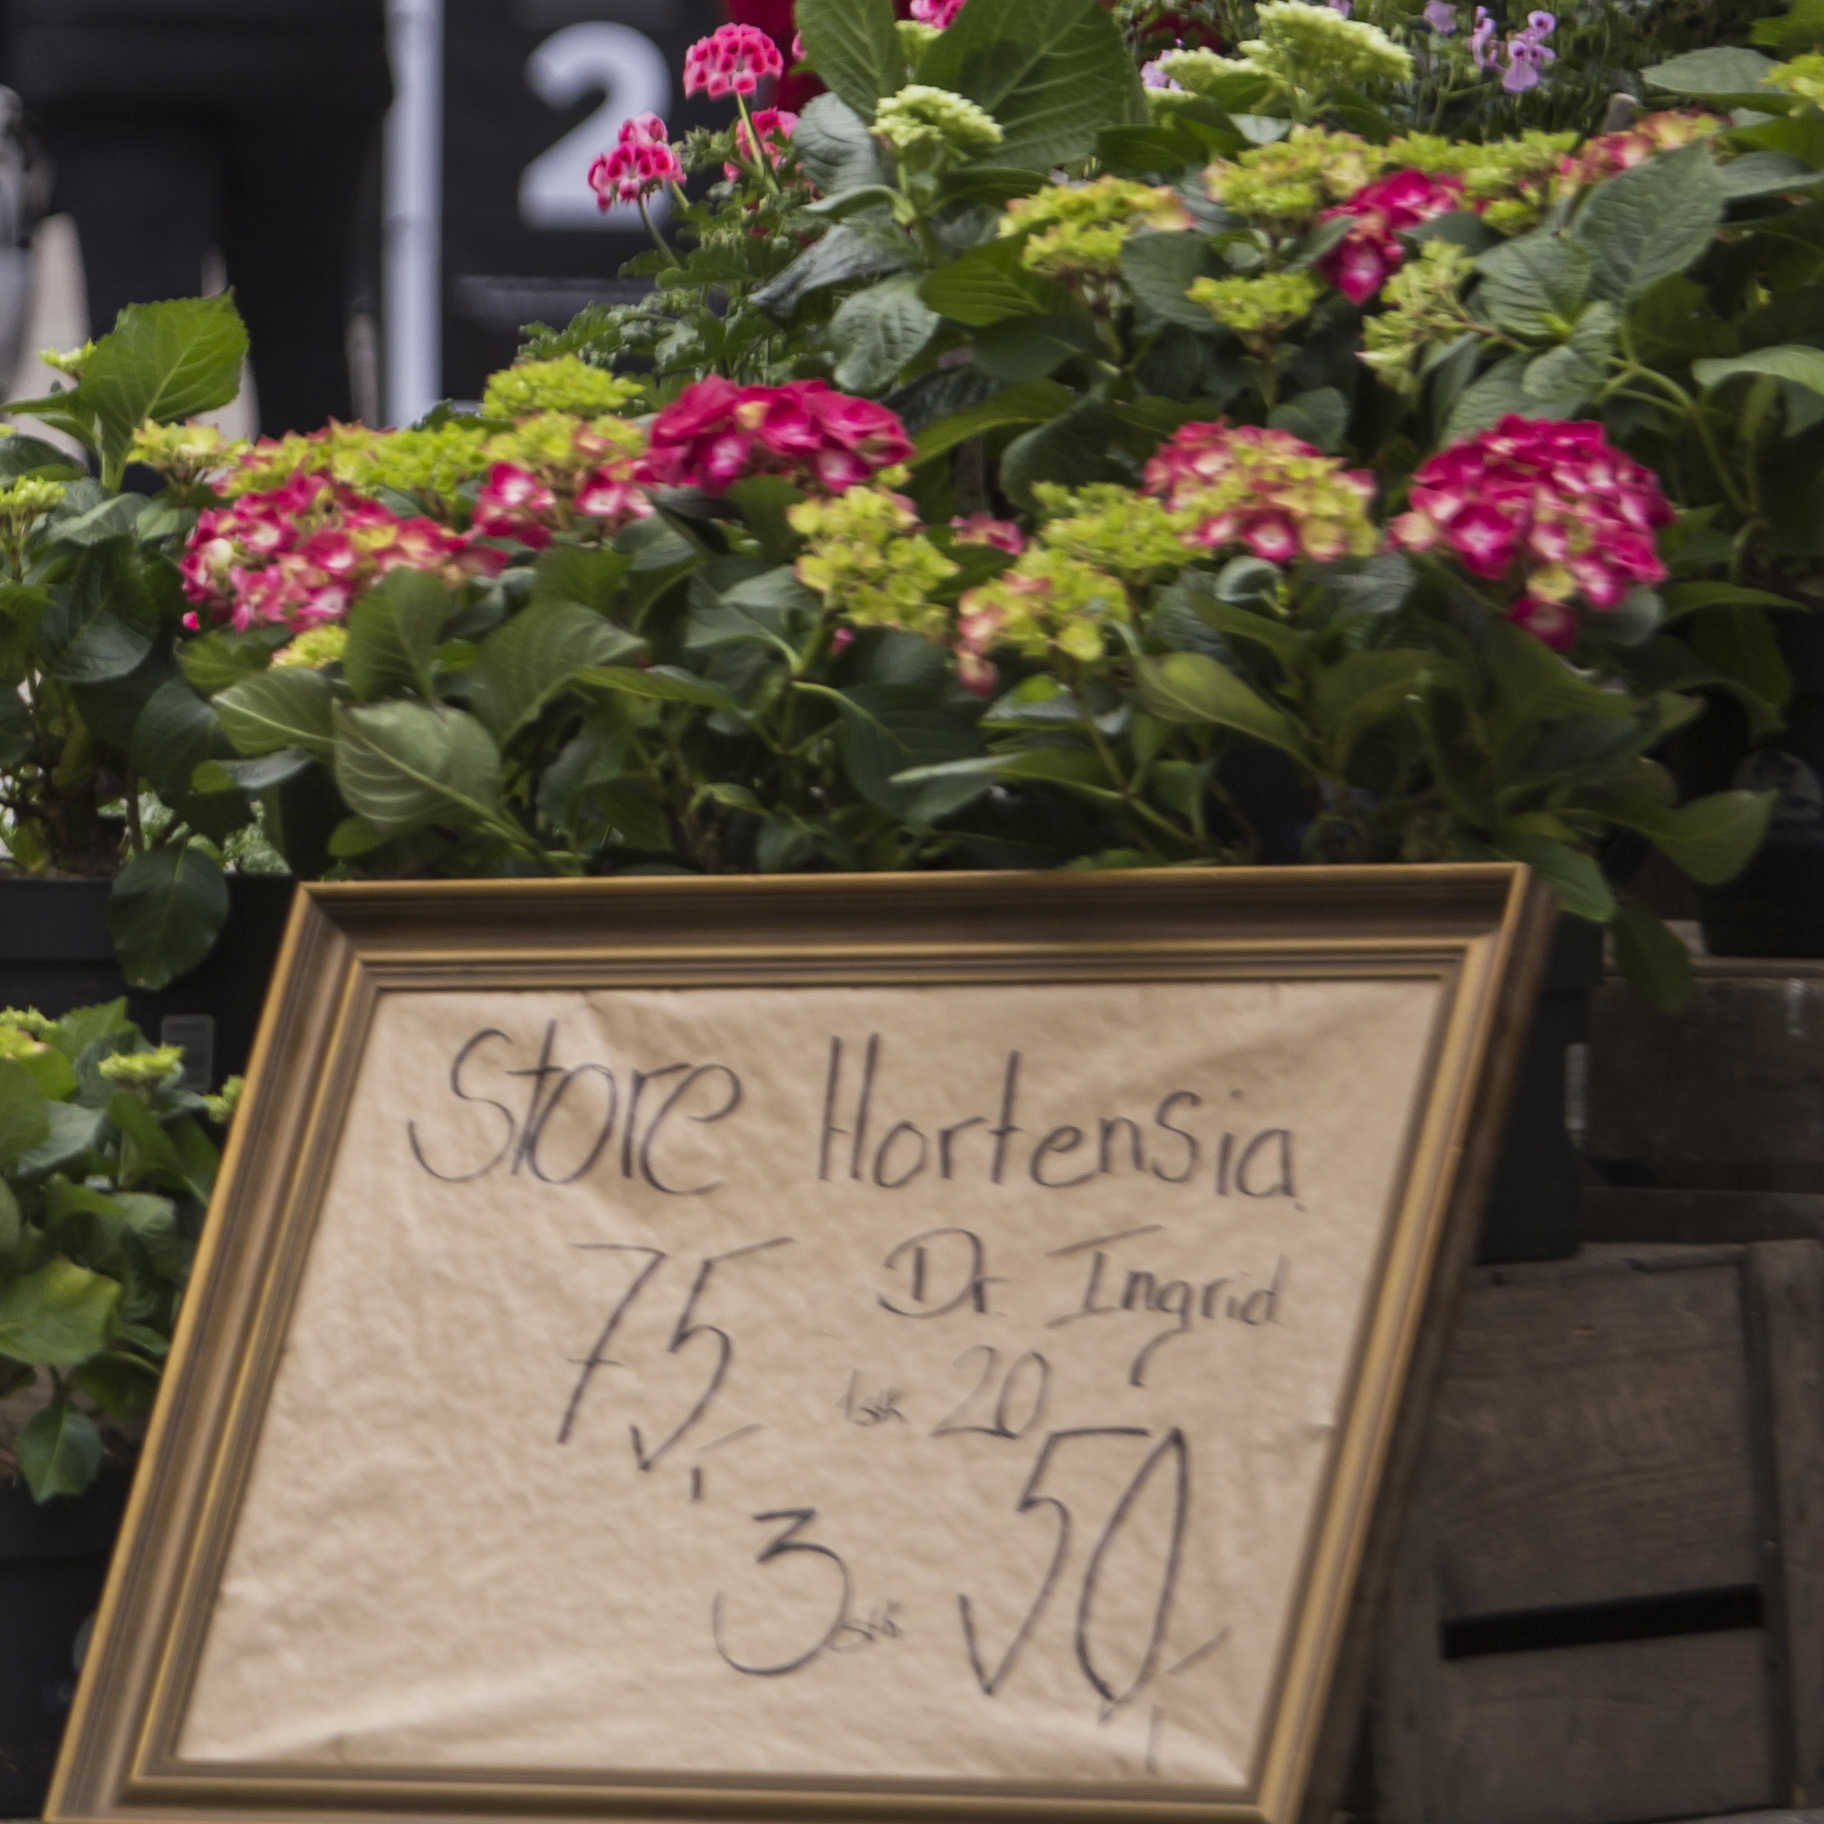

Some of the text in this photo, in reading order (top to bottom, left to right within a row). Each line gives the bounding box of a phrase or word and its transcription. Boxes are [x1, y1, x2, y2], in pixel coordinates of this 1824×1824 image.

[518, 20, 671, 231] 2
[408, 1019, 743, 1194] Store
[1045, 1224, 1290, 1387] Ingrid
[930, 1344, 1051, 1439] 20
[713, 1507, 851, 1676] 3
